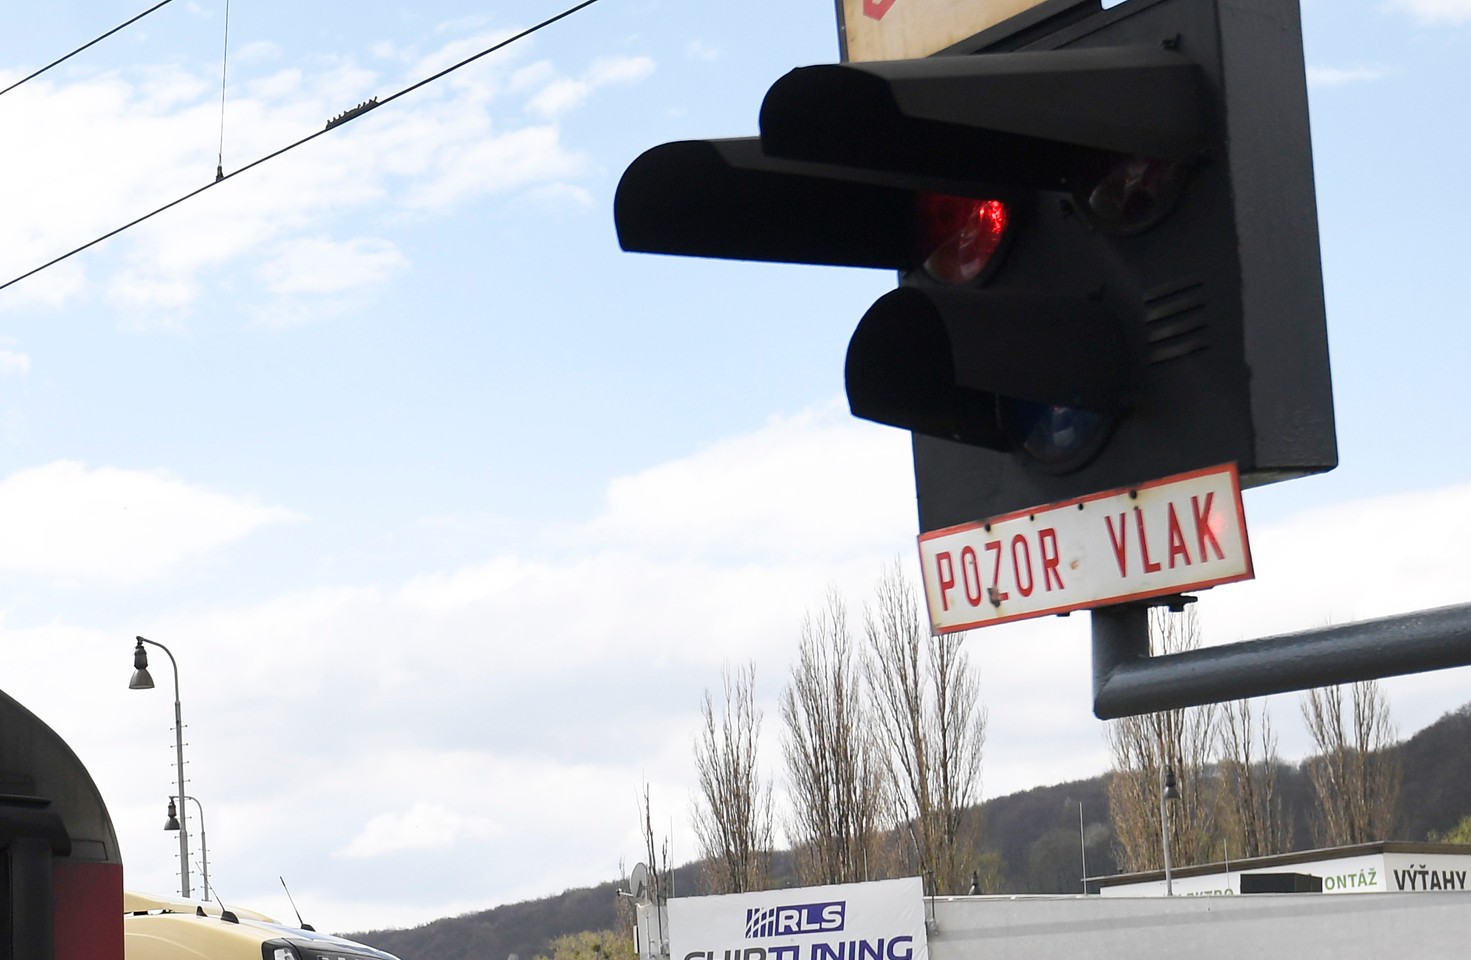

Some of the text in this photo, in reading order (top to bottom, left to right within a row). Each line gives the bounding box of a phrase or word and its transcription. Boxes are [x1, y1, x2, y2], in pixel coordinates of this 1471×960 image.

[935, 491, 1225, 612] POZOR VLAK
[1324, 867, 1378, 891] ONTÁŽ
[777, 904, 844, 934] RLS
